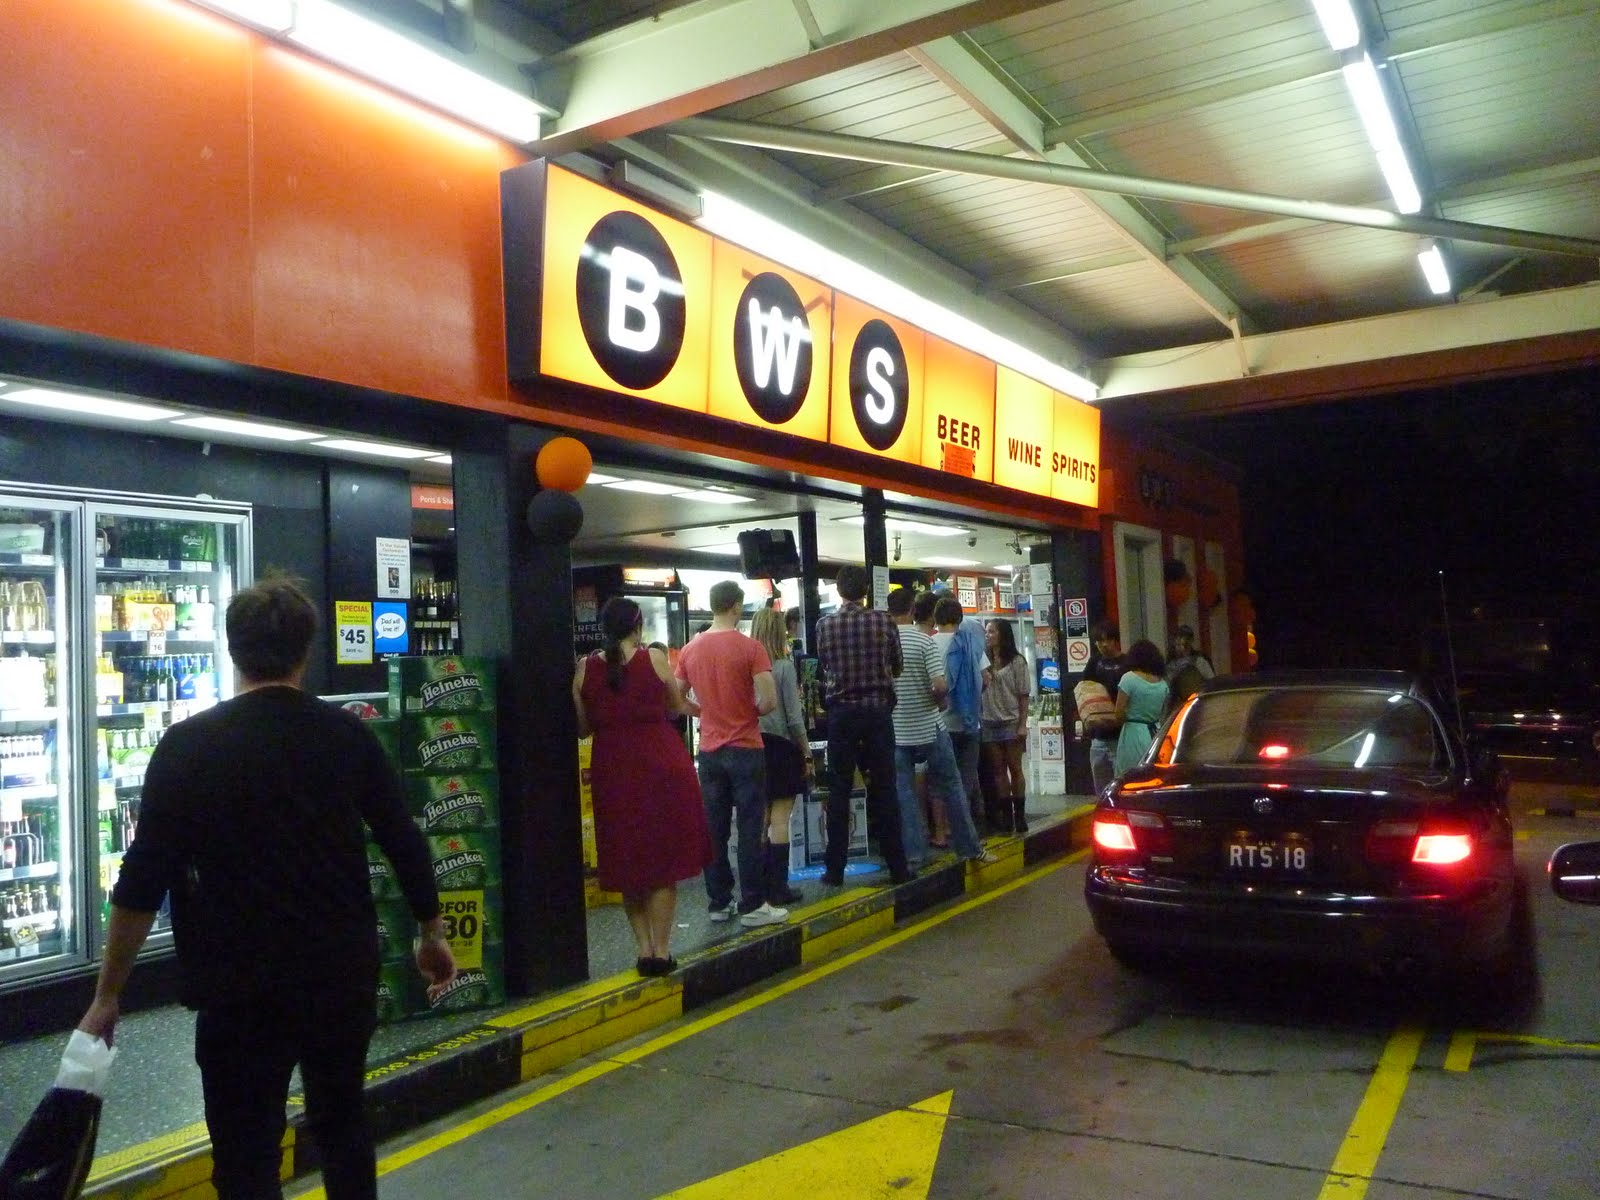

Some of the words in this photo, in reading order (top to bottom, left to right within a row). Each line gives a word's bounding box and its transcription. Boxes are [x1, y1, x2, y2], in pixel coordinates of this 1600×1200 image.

[937, 414, 980, 450] BEER
[1008, 437, 1041, 468] WINE
[1052, 452, 1096, 484] SPIRITS
[339, 605, 369, 613] SPECIAL
[340, 629, 366, 644] $45
